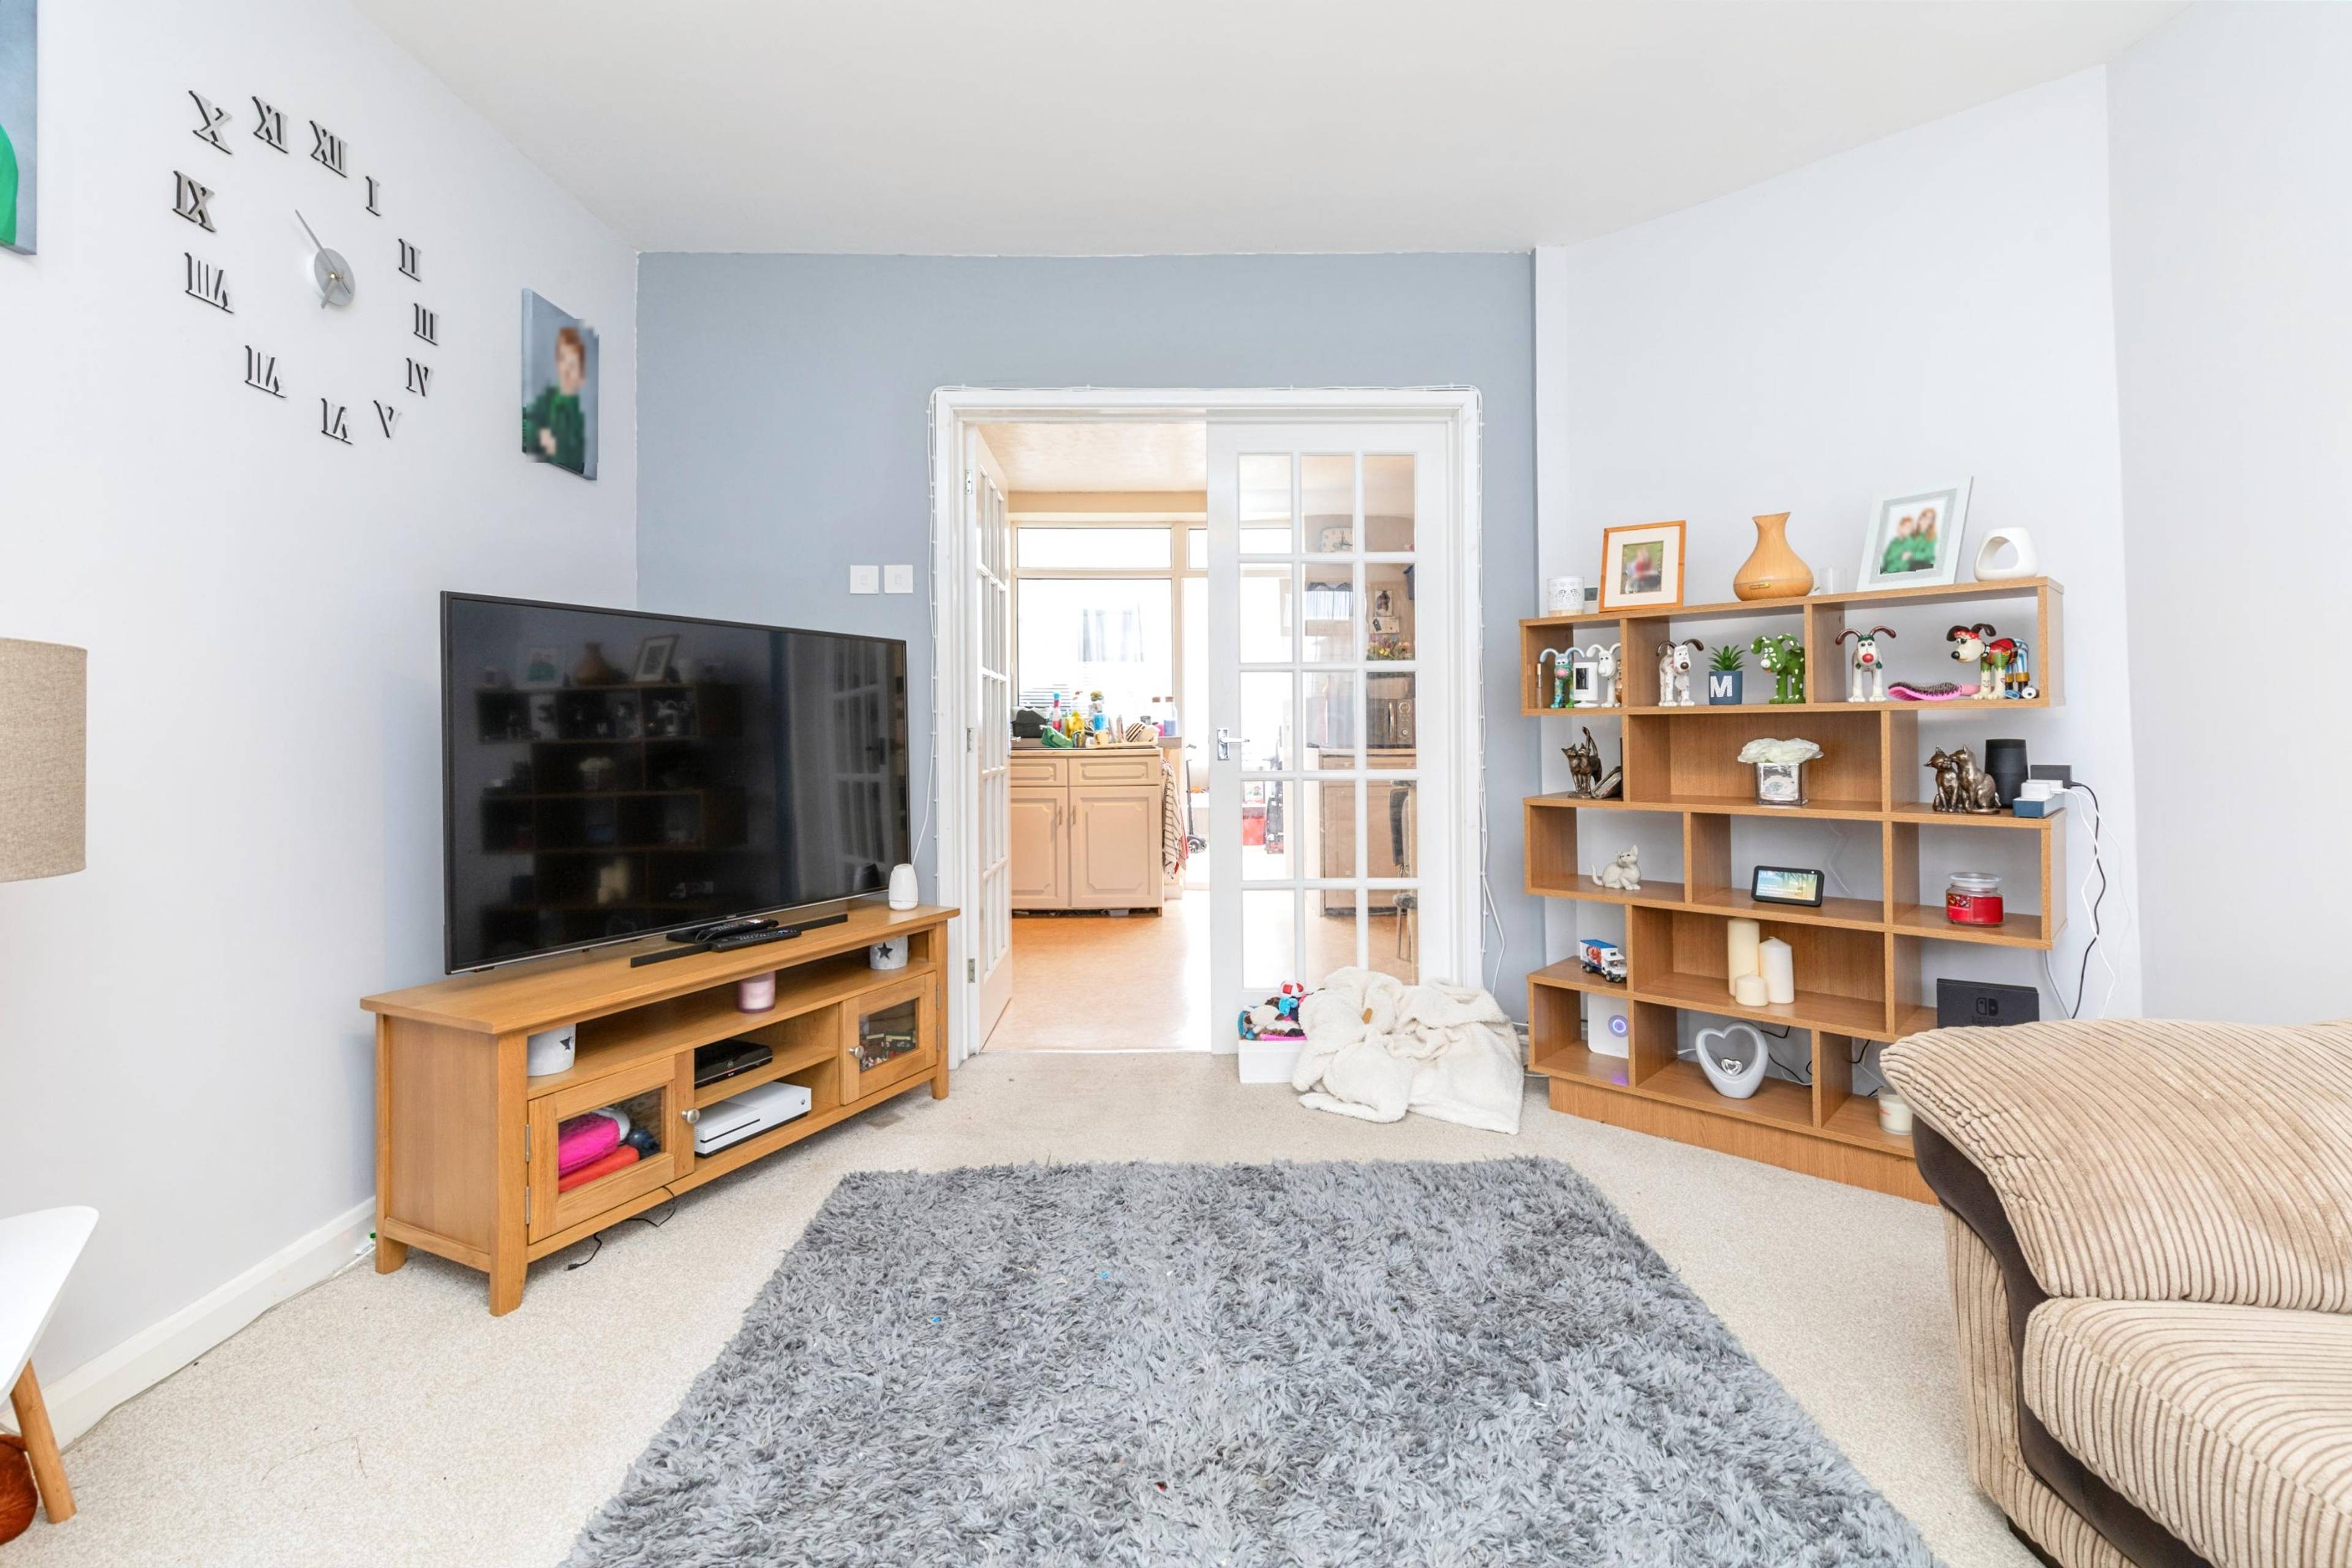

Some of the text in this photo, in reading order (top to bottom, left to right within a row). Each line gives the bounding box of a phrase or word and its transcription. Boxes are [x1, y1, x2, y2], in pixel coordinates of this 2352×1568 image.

[187, 89, 233, 156] X
[251, 96, 289, 154] XI
[309, 119, 349, 179] XII
[172, 170, 217, 233] IX
[398, 238, 423, 282] II
[413, 303, 440, 347] III
[1710, 675, 1733, 698] M
